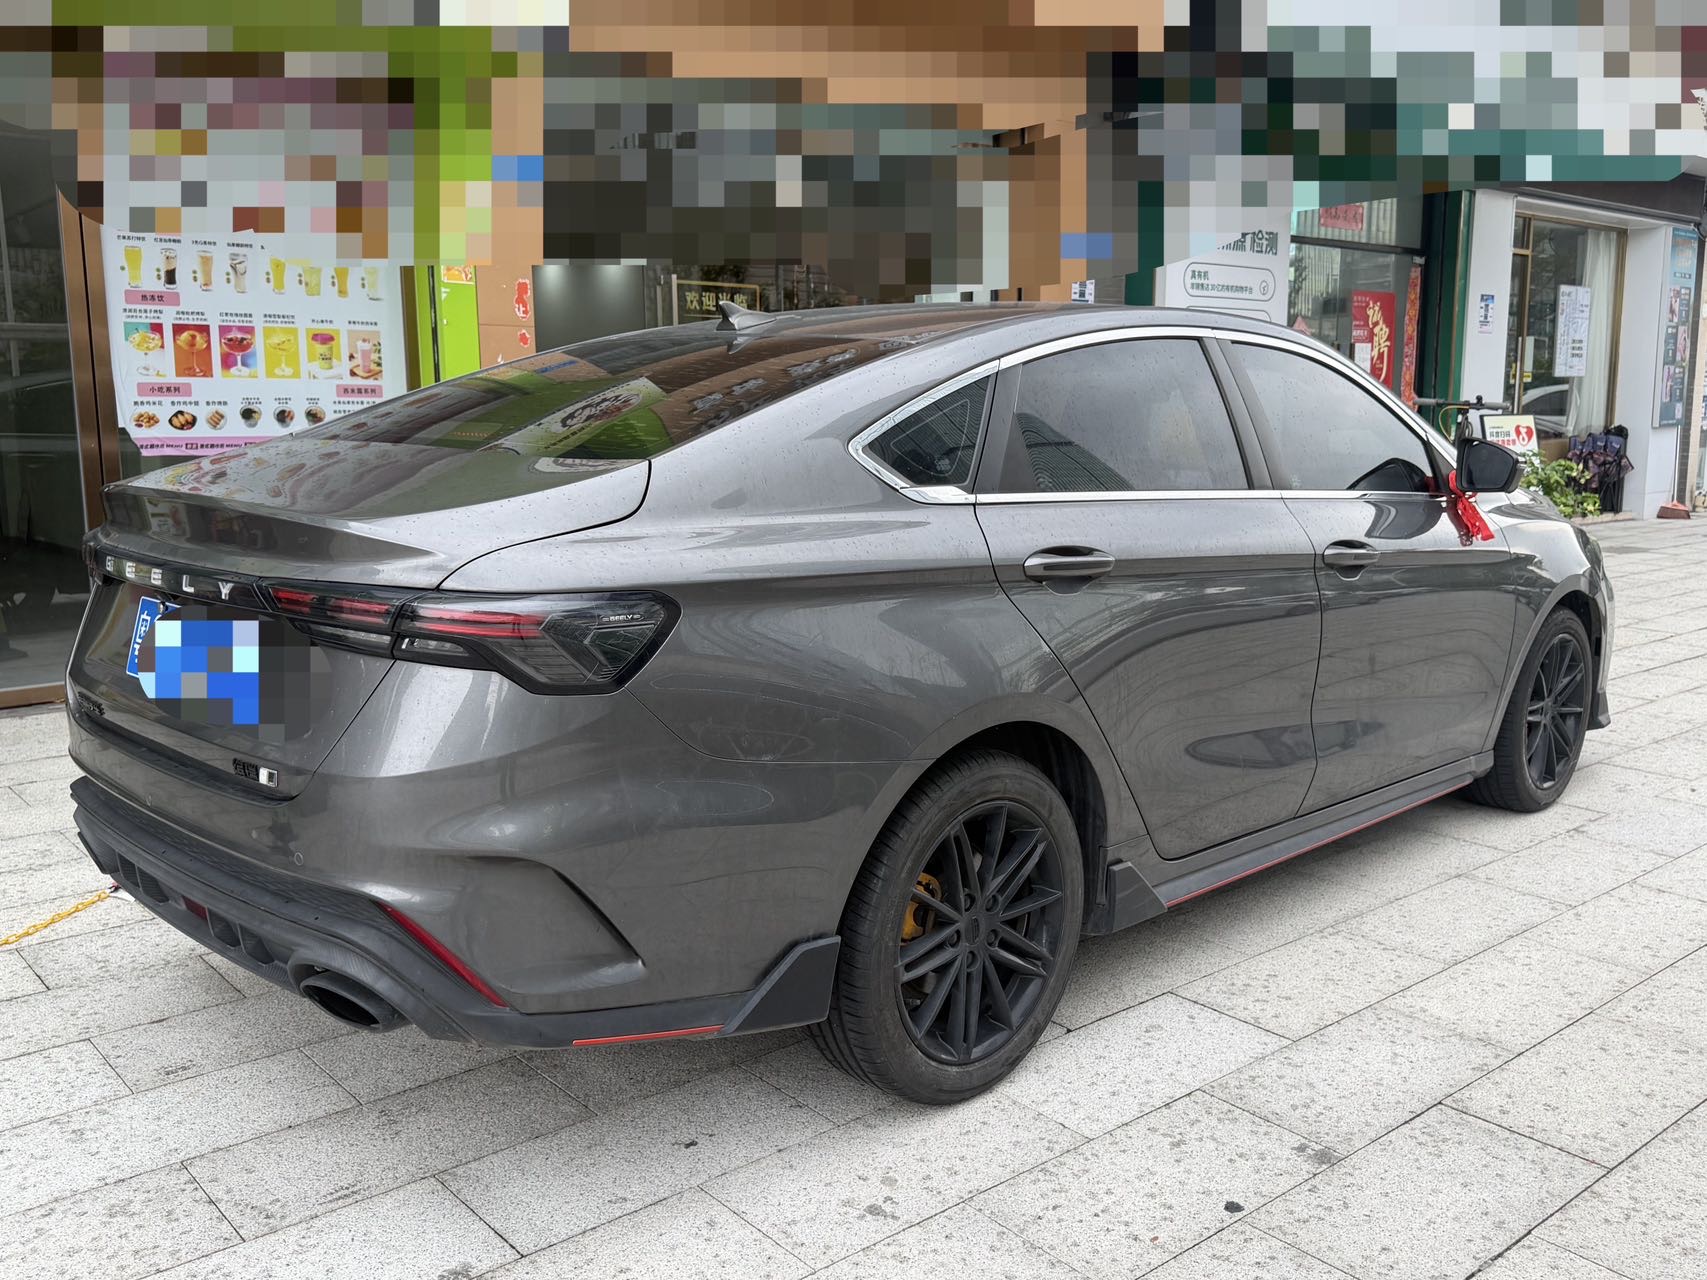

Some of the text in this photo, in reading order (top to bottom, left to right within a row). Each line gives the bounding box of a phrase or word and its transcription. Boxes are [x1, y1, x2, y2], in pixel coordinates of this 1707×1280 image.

[149, 386, 181, 394] 小吃系列
[106, 556, 234, 600] GEELY
